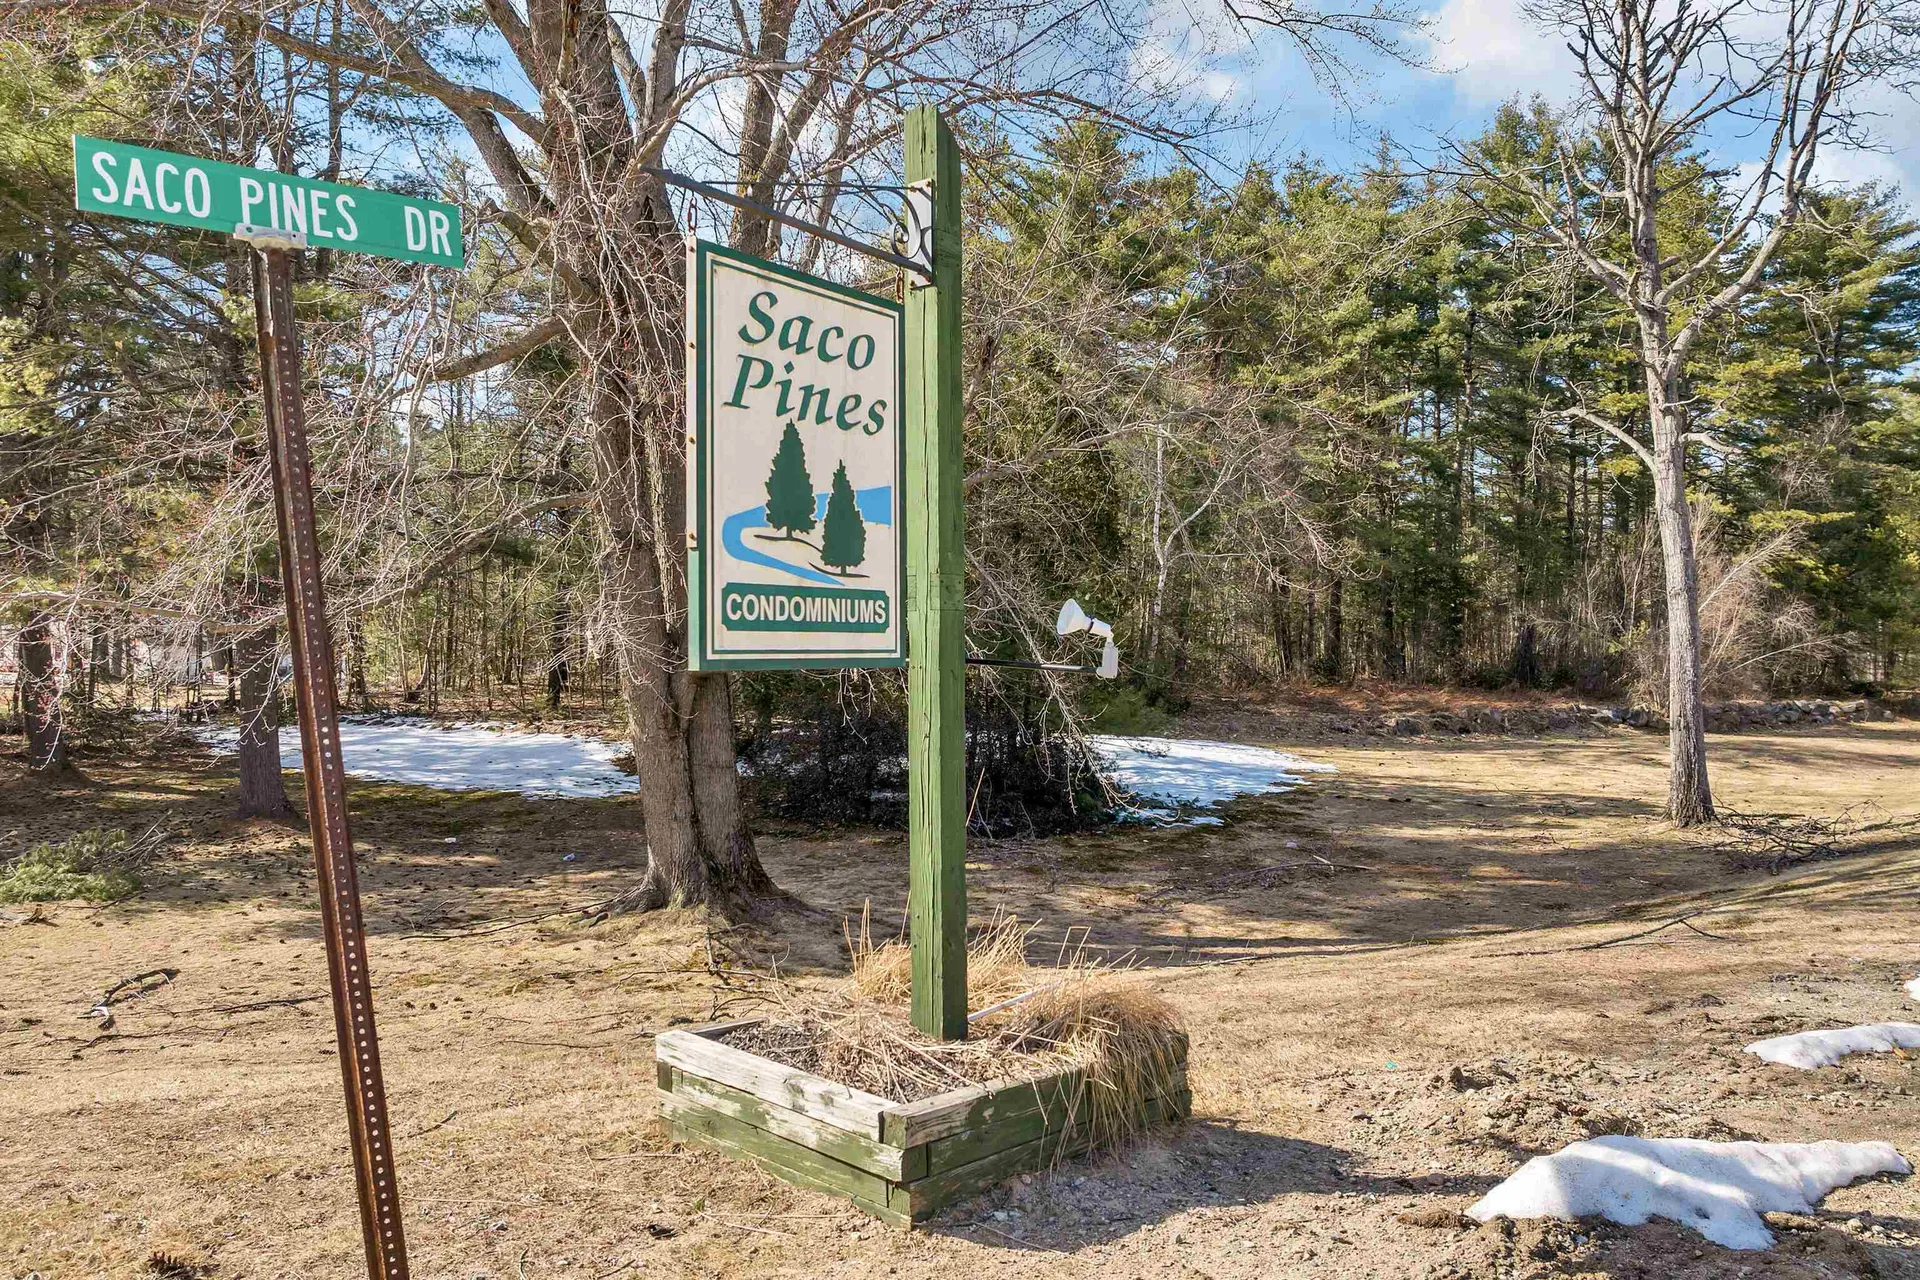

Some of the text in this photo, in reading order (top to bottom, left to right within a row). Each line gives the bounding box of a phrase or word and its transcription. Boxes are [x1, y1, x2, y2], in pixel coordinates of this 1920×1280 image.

[91, 151, 453, 257] SACO PINES DR
[737, 291, 876, 371] Saco
[721, 353, 888, 436] Pines
[726, 593, 887, 624] CONDOMINIUMS
